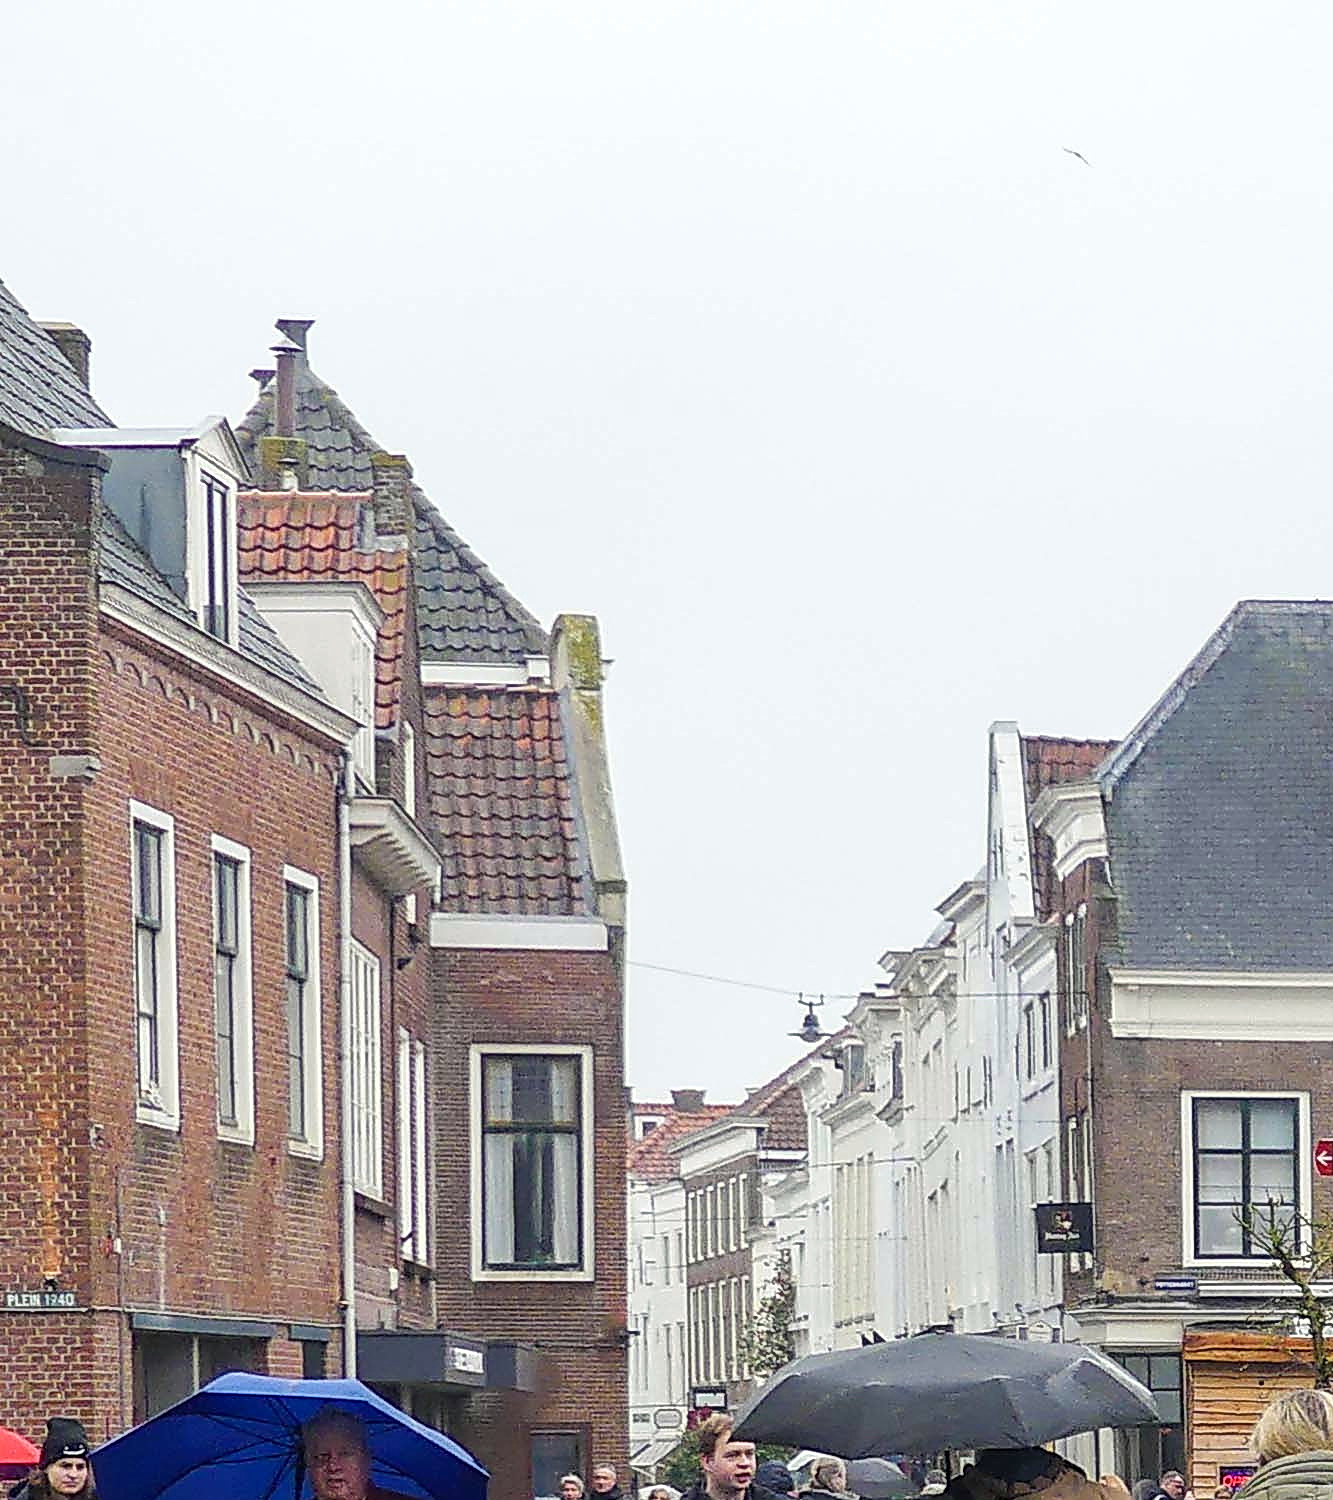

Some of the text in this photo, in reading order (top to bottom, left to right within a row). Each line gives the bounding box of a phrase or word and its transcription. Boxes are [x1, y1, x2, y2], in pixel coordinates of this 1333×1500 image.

[6, 1293, 75, 1307] PLEIN 1940
[1222, 1474, 1250, 1487] OPE
